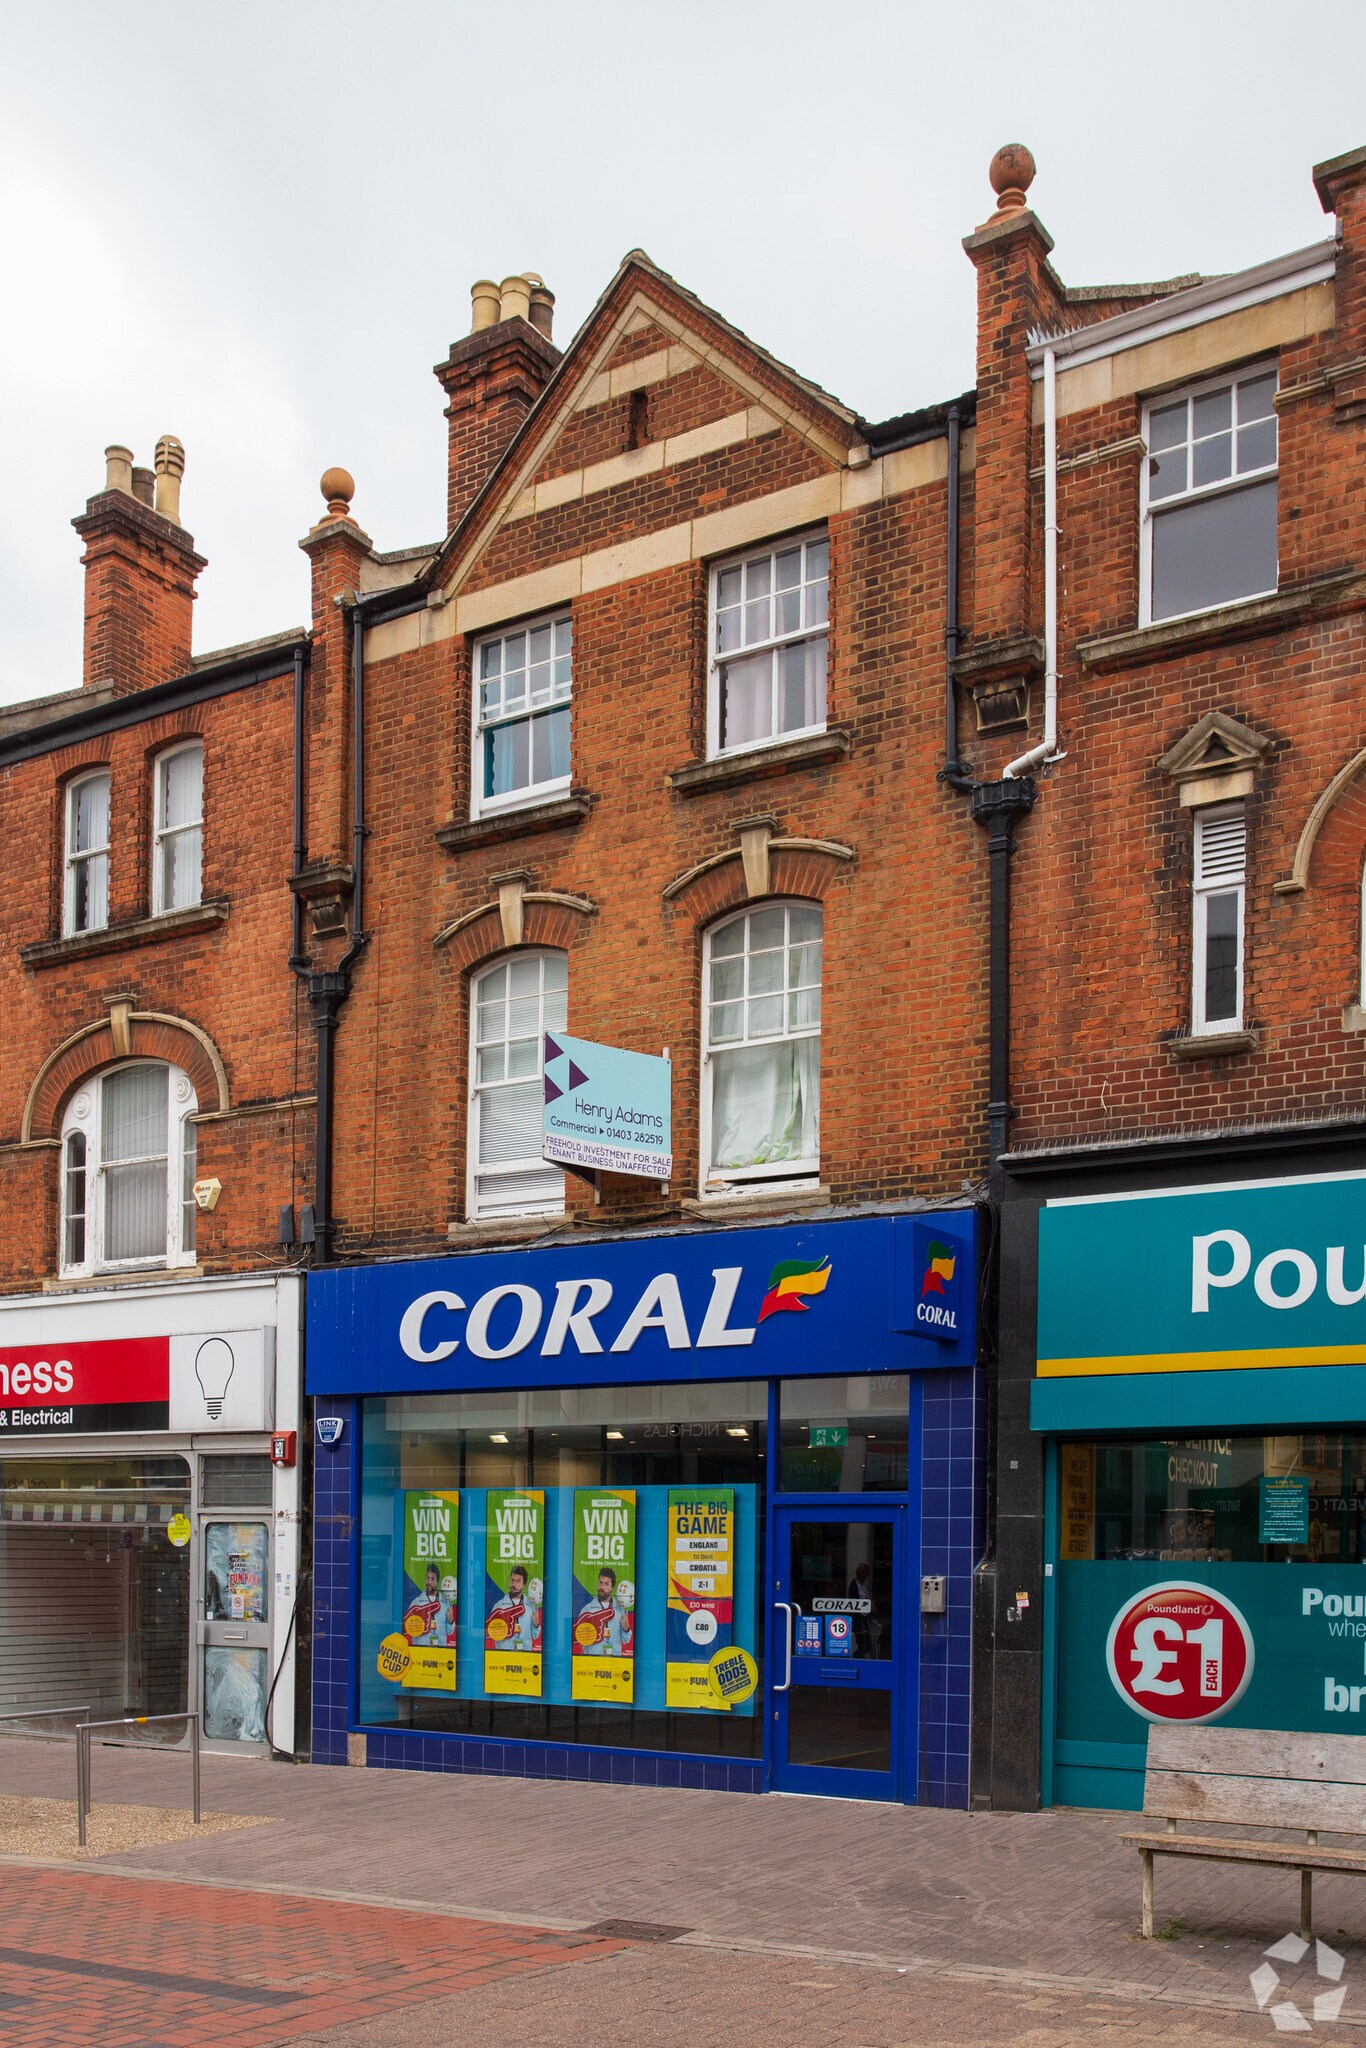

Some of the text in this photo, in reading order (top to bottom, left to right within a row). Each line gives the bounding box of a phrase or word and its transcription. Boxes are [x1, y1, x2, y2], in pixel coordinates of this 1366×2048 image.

[575, 1097, 663, 1128] Henry Adams
[550, 1116, 664, 1145] Commercial 01403 282519
[546, 1136, 671, 1167] FREEHOLD INVESTMENT FOR SALE
[548, 1146, 668, 1175] TENANT BUSINESS UNAFFECTED
[1191, 1229, 1366, 1313] Pou
[399, 1266, 757, 1363] CORAL
[916, 1303, 957, 1328] CORAL
[12, 1407, 74, 1426] Electrical
[1168, 1456, 1219, 1487] CHECKOUT
[675, 1501, 728, 1515] THE BIG
[412, 1508, 450, 1532] WIN
[495, 1509, 537, 1533] WIN
[583, 1509, 628, 1534] WIN
[676, 1516, 727, 1535] GAME
[416, 1533, 447, 1557] BIG
[500, 1534, 534, 1558] BIG
[587, 1535, 625, 1560] BIG
[689, 1541, 719, 1549] ENGLAND
[229, 1573, 243, 1585] FUN
[689, 1564, 717, 1572] CROATIA
[698, 1580, 709, 1588] 2-1
[814, 1600, 862, 1611] CORAL
[1147, 1603, 1201, 1614] Poundland
[1302, 1587, 1366, 1617] Pou
[695, 1623, 709, 1631] £80
[832, 1623, 845, 1633] 18
[1328, 1619, 1366, 1638] whe
[378, 1645, 410, 1667] WORLD
[382, 1658, 402, 1674] CUP
[422, 1659, 438, 1669] FUN
[714, 1653, 743, 1675] TREBLE
[1130, 1616, 1224, 1698] £1
[505, 1664, 522, 1673] FUN
[594, 1670, 612, 1679] FUN
[717, 1663, 748, 1686] ODDS
[1206, 1659, 1219, 1692] EACH
[690, 1677, 708, 1686] FUN
[1324, 1677, 1366, 1713] br
